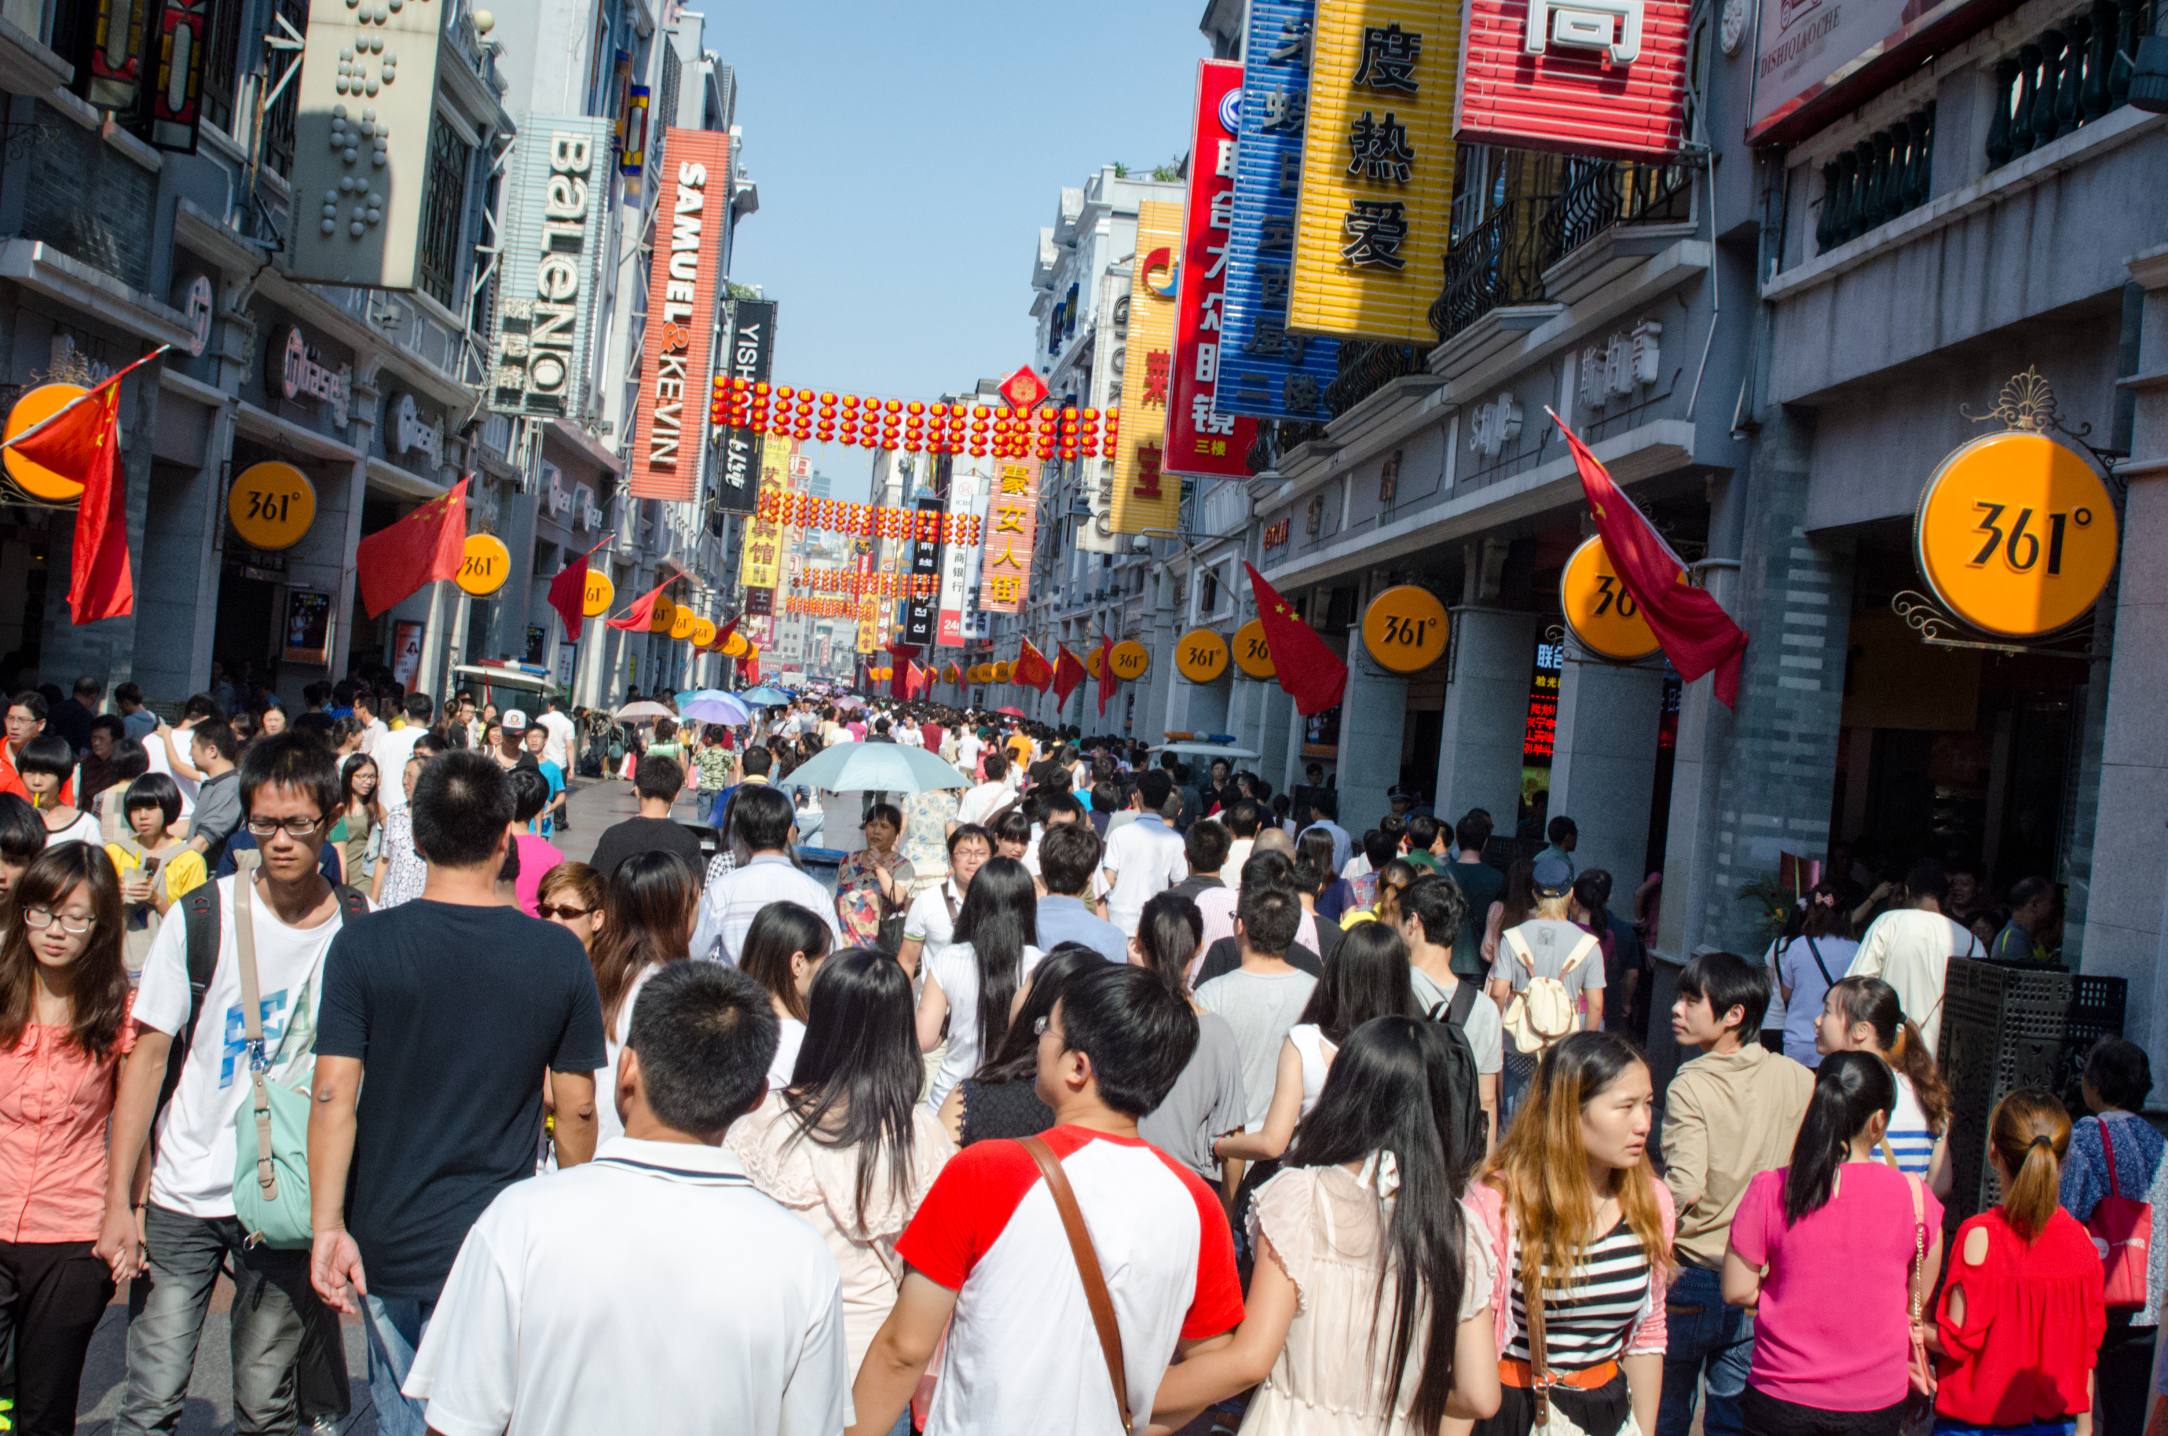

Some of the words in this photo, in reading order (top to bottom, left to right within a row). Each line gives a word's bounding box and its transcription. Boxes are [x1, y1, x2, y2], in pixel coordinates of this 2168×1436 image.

[1341, 23, 1423, 270] 度热爱
[663, 160, 709, 323] SAMUEL
[660, 321, 691, 354] &
[650, 354, 687, 465] KEVIN
[246, 490, 301, 524] 361°
[991, 426, 1034, 605] 豪女人街
[1965, 499, 2094, 577] 361°
[463, 554, 499, 578] 361°
[585, 585, 608, 603] 61°
[653, 607, 670, 621] 61°
[1381, 615, 1437, 649] 361°
[1118, 652, 1144, 670] 361°
[1188, 645, 1222, 668] 361°
